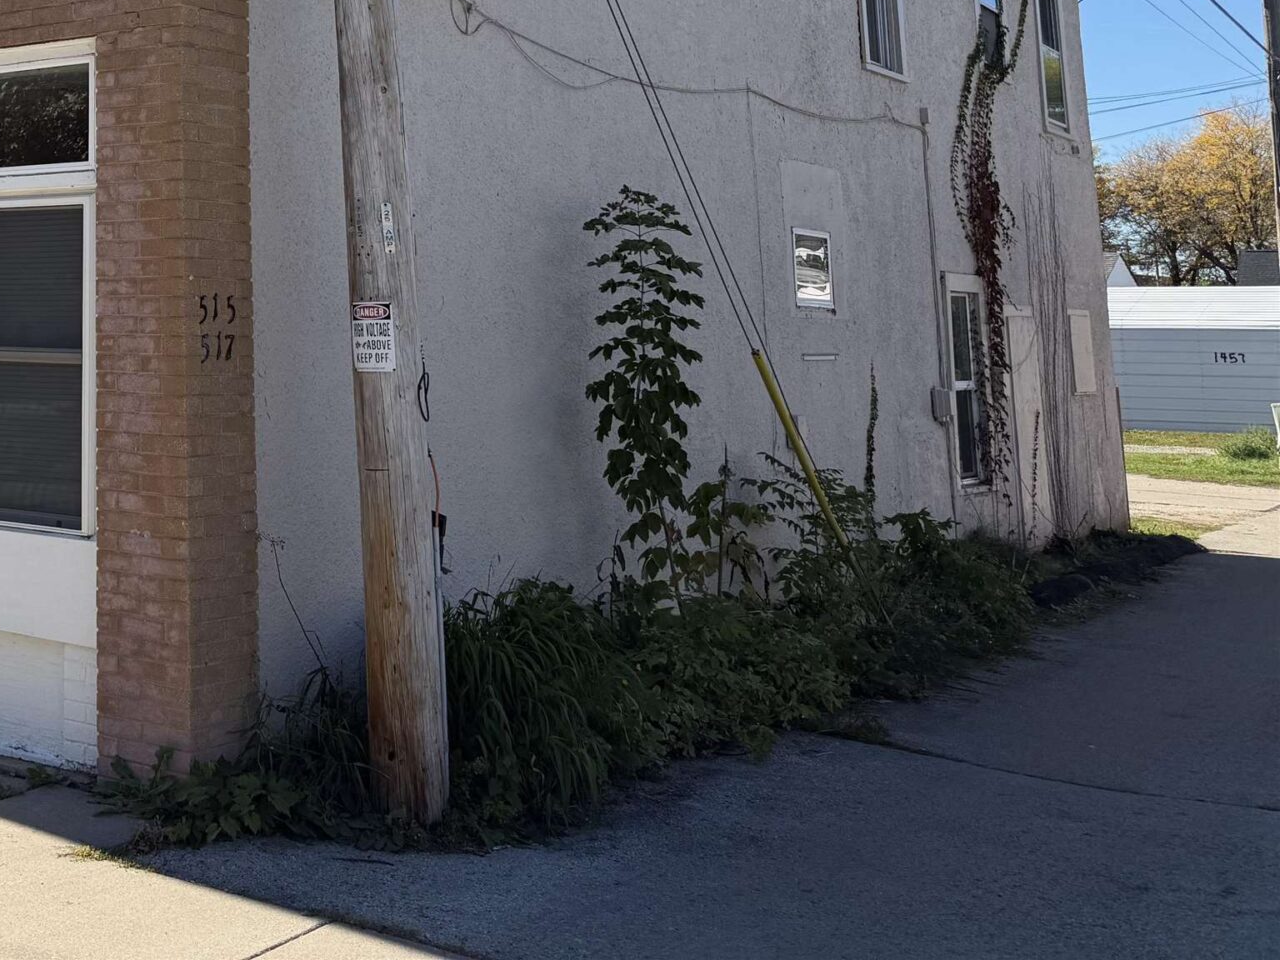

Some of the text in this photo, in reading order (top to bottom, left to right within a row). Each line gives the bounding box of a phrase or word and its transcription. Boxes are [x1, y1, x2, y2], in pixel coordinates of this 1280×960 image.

[199, 292, 236, 325] 515
[356, 307, 384, 317] DANGER
[365, 322, 391, 337] VOLTAGE
[201, 331, 235, 364] 517
[366, 339, 392, 350] ABOVE
[356, 352, 390, 364] KEEP OFF
[1214, 351, 1246, 364] 1457
